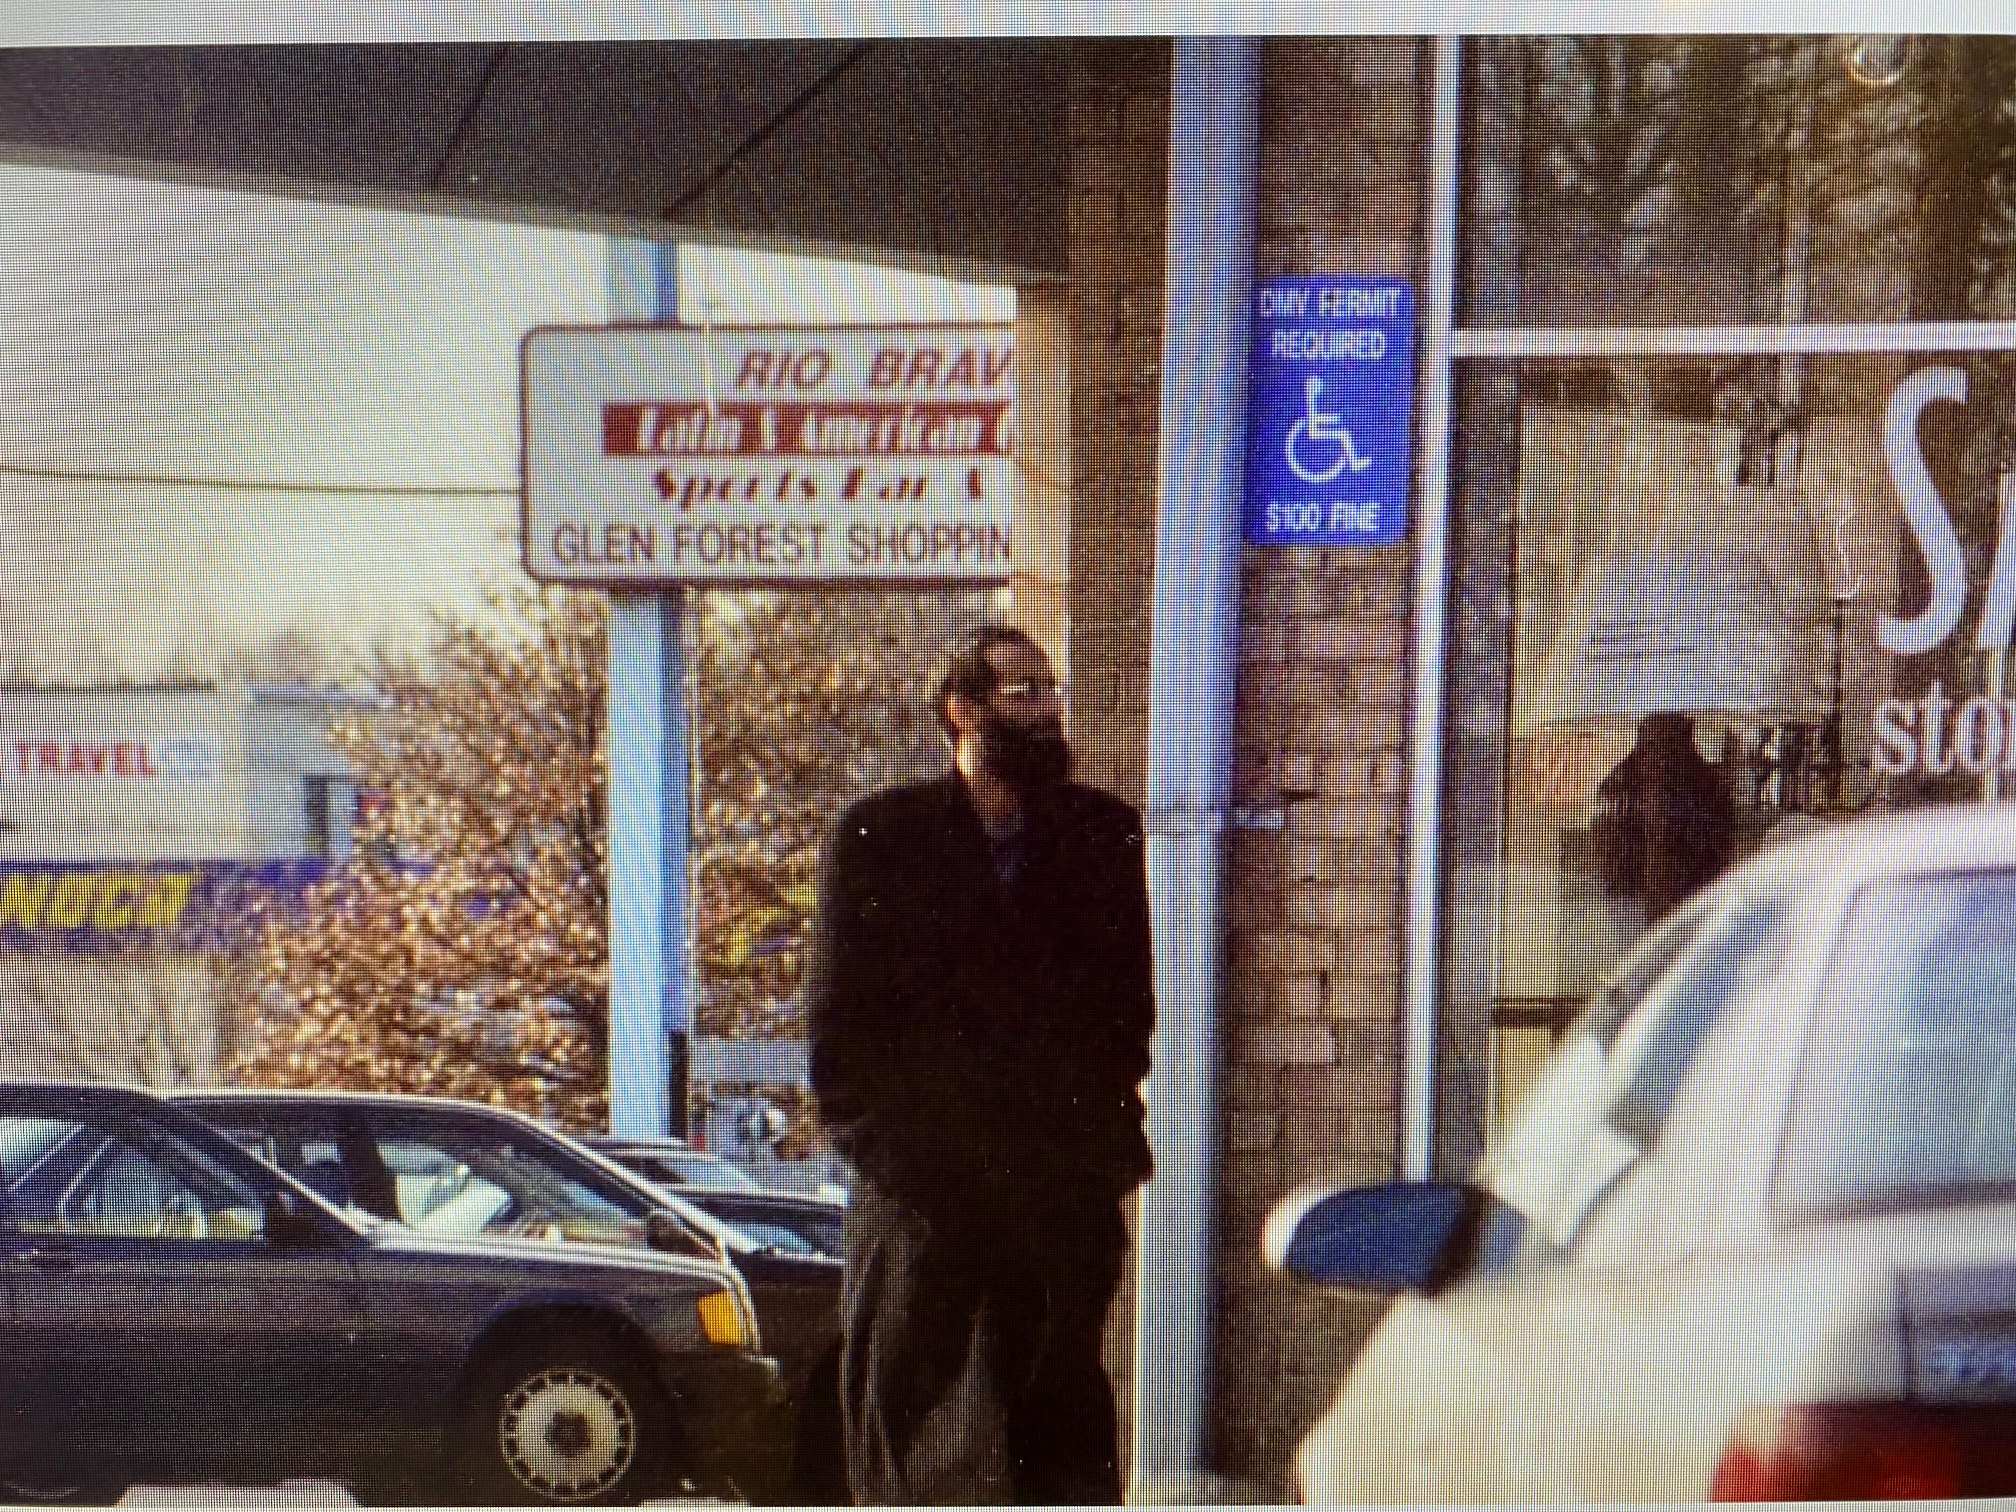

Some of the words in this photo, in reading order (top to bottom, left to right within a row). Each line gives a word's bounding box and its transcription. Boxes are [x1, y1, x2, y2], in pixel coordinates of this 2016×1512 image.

[1259, 288, 1311, 318] DMV
[1271, 330, 1388, 361] REQUIRED
[735, 348, 832, 390] RIO
[865, 347, 1012, 390] BRAV
[635, 405, 744, 452] Latin
[801, 405, 984, 452] American
[652, 466, 818, 512] Sports
[1265, 501, 1321, 532] $100
[1328, 501, 1382, 532] FINE
[551, 522, 656, 566] GLEN
[673, 522, 827, 566] FOREST
[846, 521, 1012, 566] SHOPPIN
[13, 740, 158, 777] TRAVEL
